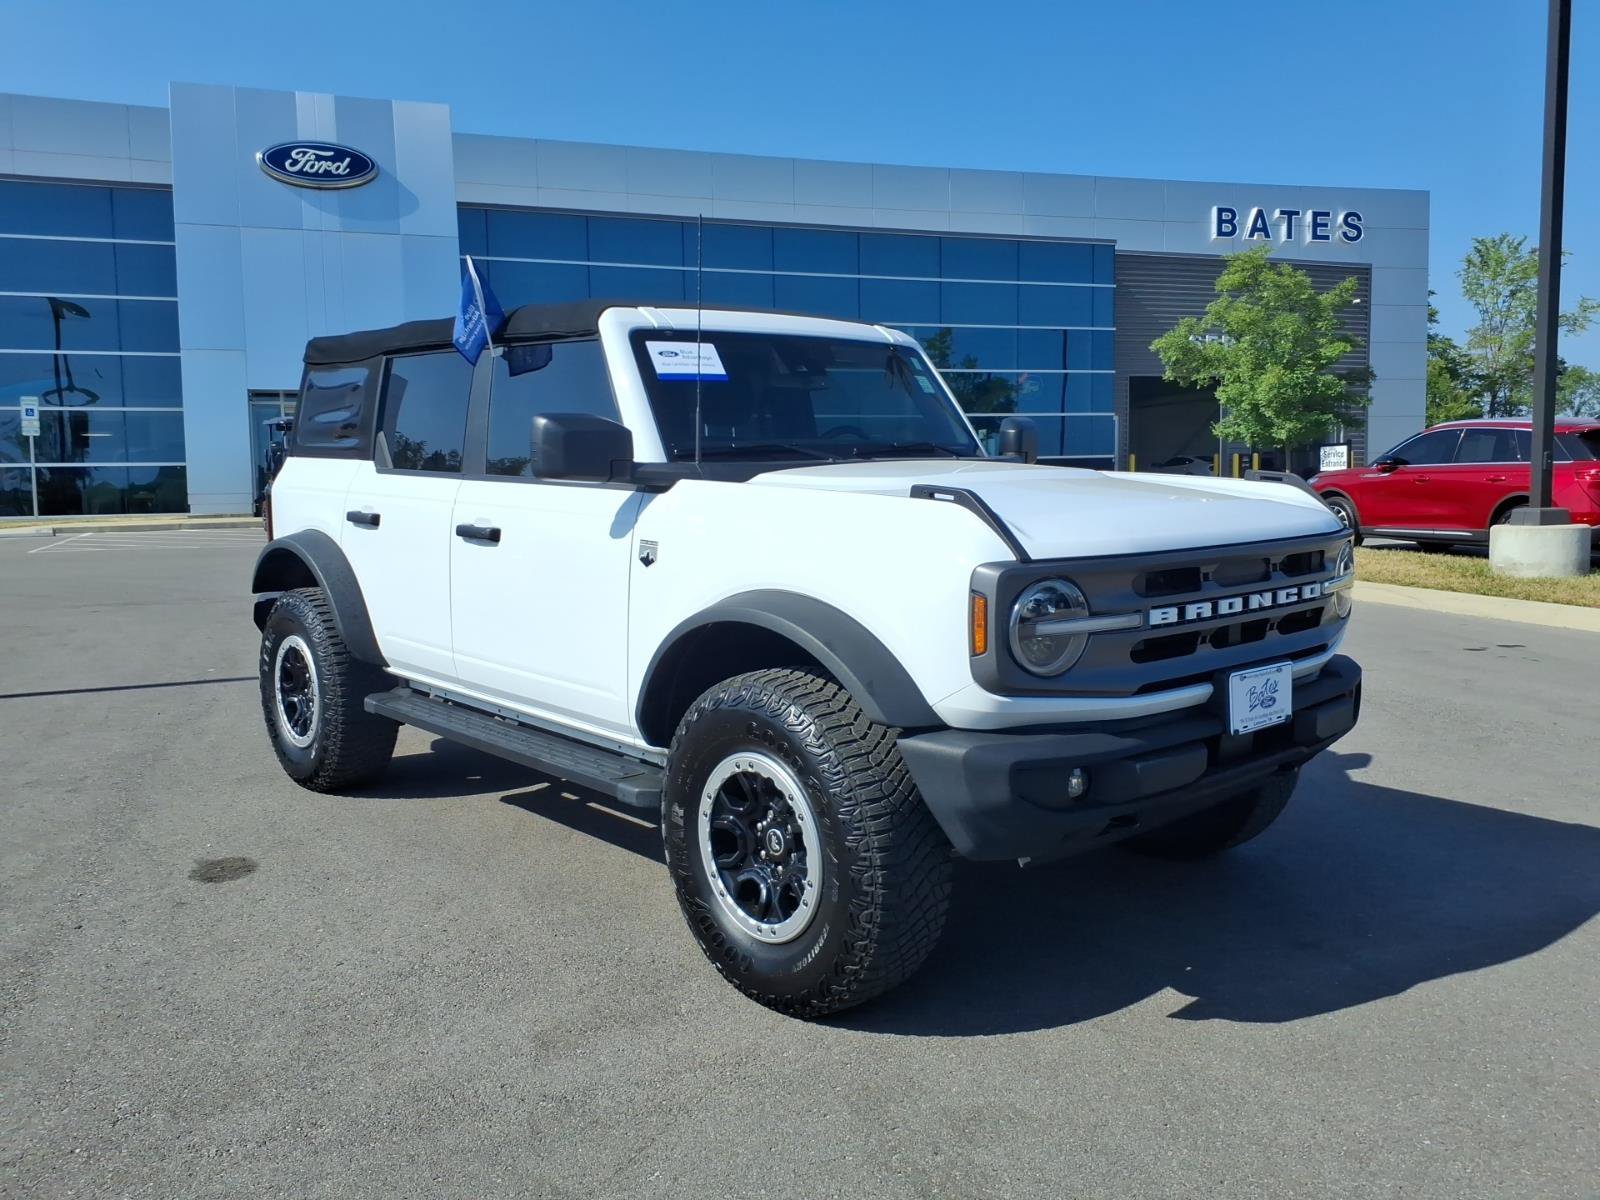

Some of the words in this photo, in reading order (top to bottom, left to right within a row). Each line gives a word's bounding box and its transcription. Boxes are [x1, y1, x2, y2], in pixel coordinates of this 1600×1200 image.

[285, 148, 351, 175] Ford
[1211, 205, 1363, 243] BATES
[1322, 450, 1345, 458] Service
[1150, 583, 1321, 626] BRONCO
